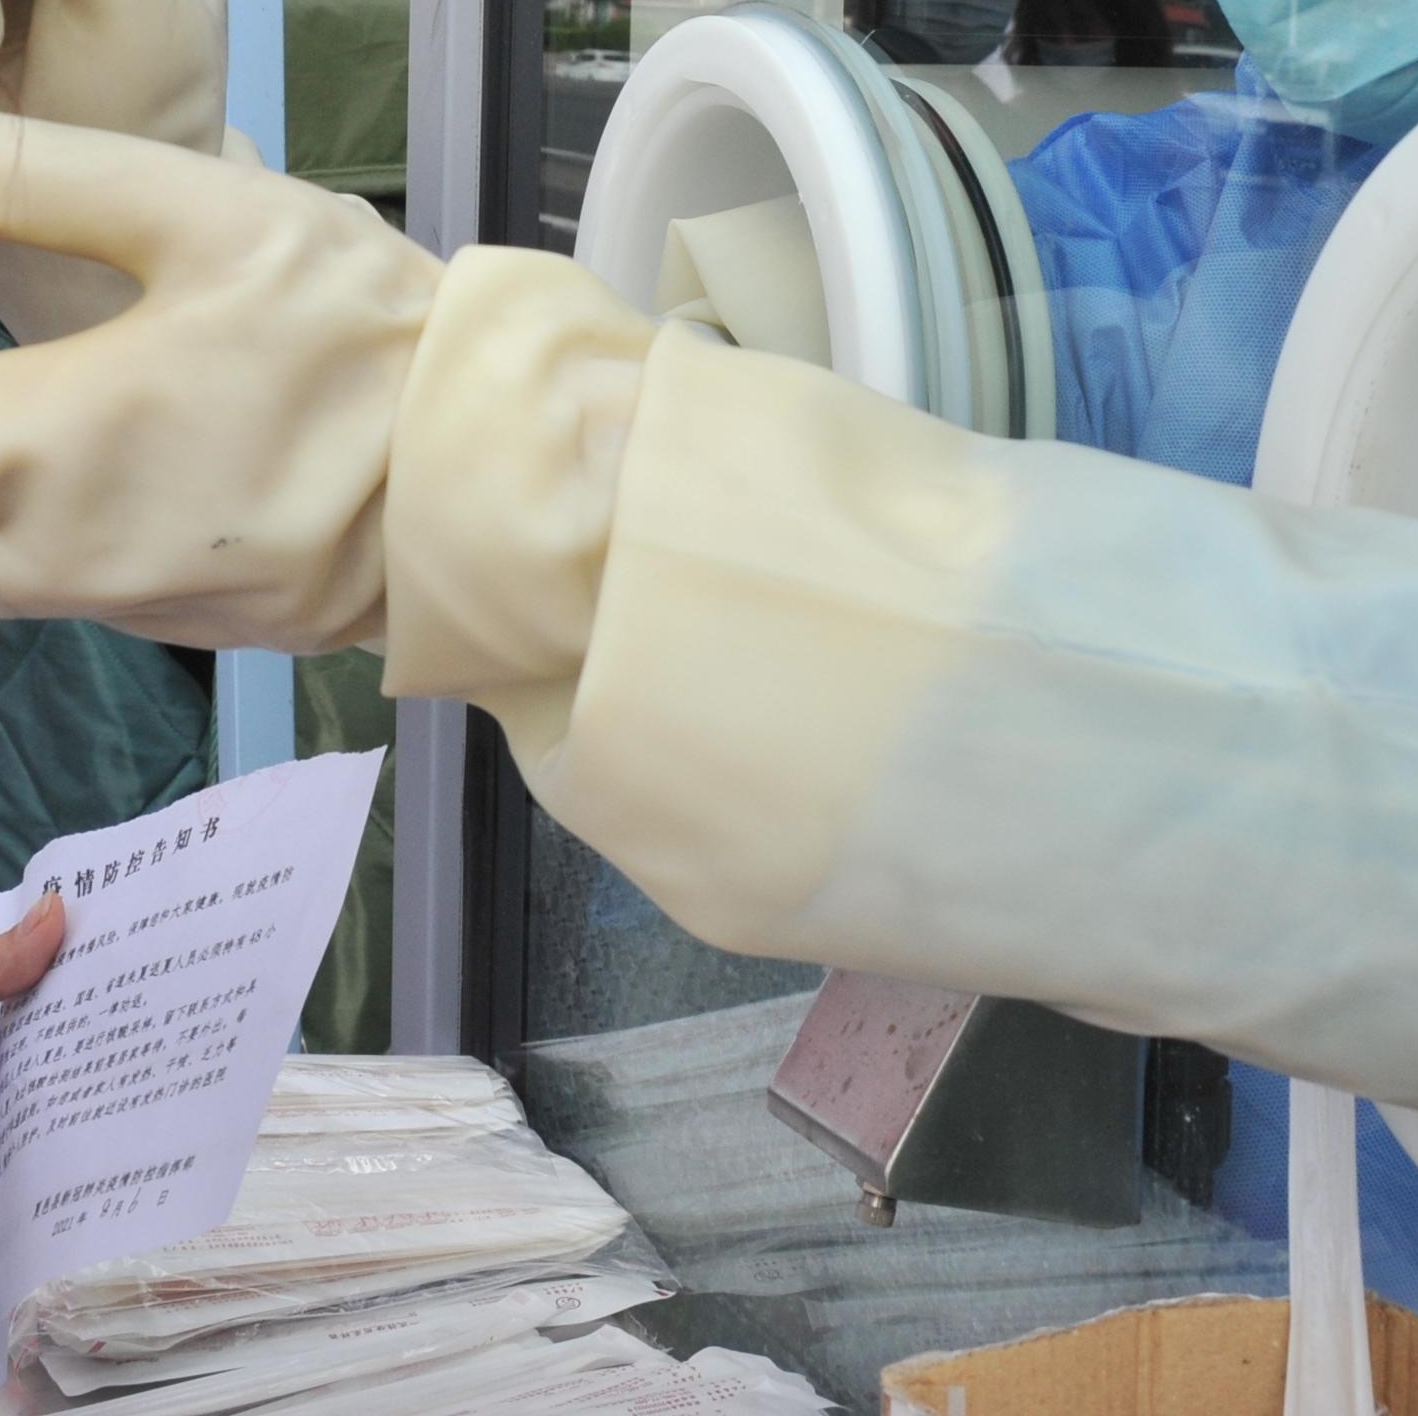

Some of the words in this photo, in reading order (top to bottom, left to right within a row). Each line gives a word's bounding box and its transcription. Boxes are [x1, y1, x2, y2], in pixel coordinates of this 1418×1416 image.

[42, 816, 221, 898] 疫情防控告知书
